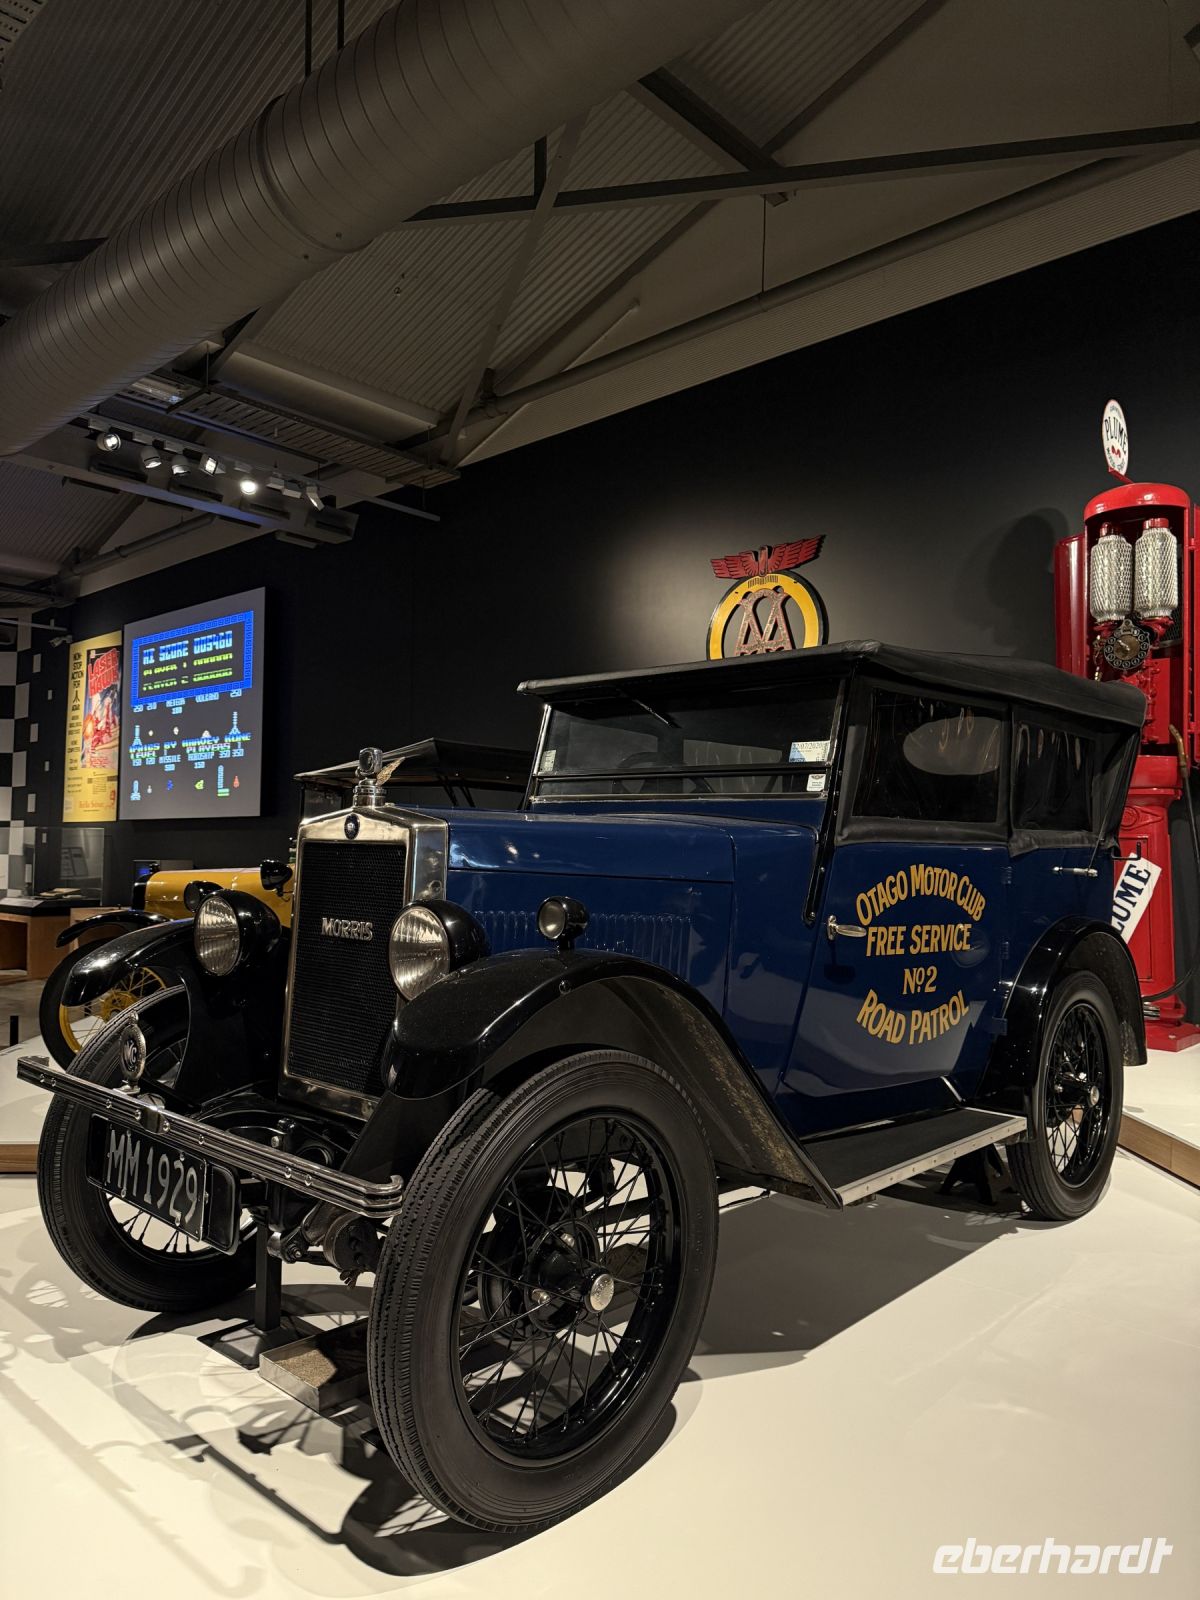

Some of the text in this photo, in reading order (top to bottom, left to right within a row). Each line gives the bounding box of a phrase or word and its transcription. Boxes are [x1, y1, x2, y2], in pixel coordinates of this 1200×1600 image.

[1104, 416, 1128, 455] PLUME
[159, 640, 189, 662] SCORE
[856, 863, 986, 926] OTAGO MOTOR CLUB
[321, 917, 373, 941] MORRIS
[866, 923, 972, 957] FREE SERVICE
[856, 988, 970, 1045] ROAD PATROL
[107, 1129, 198, 1225] MM 1929
